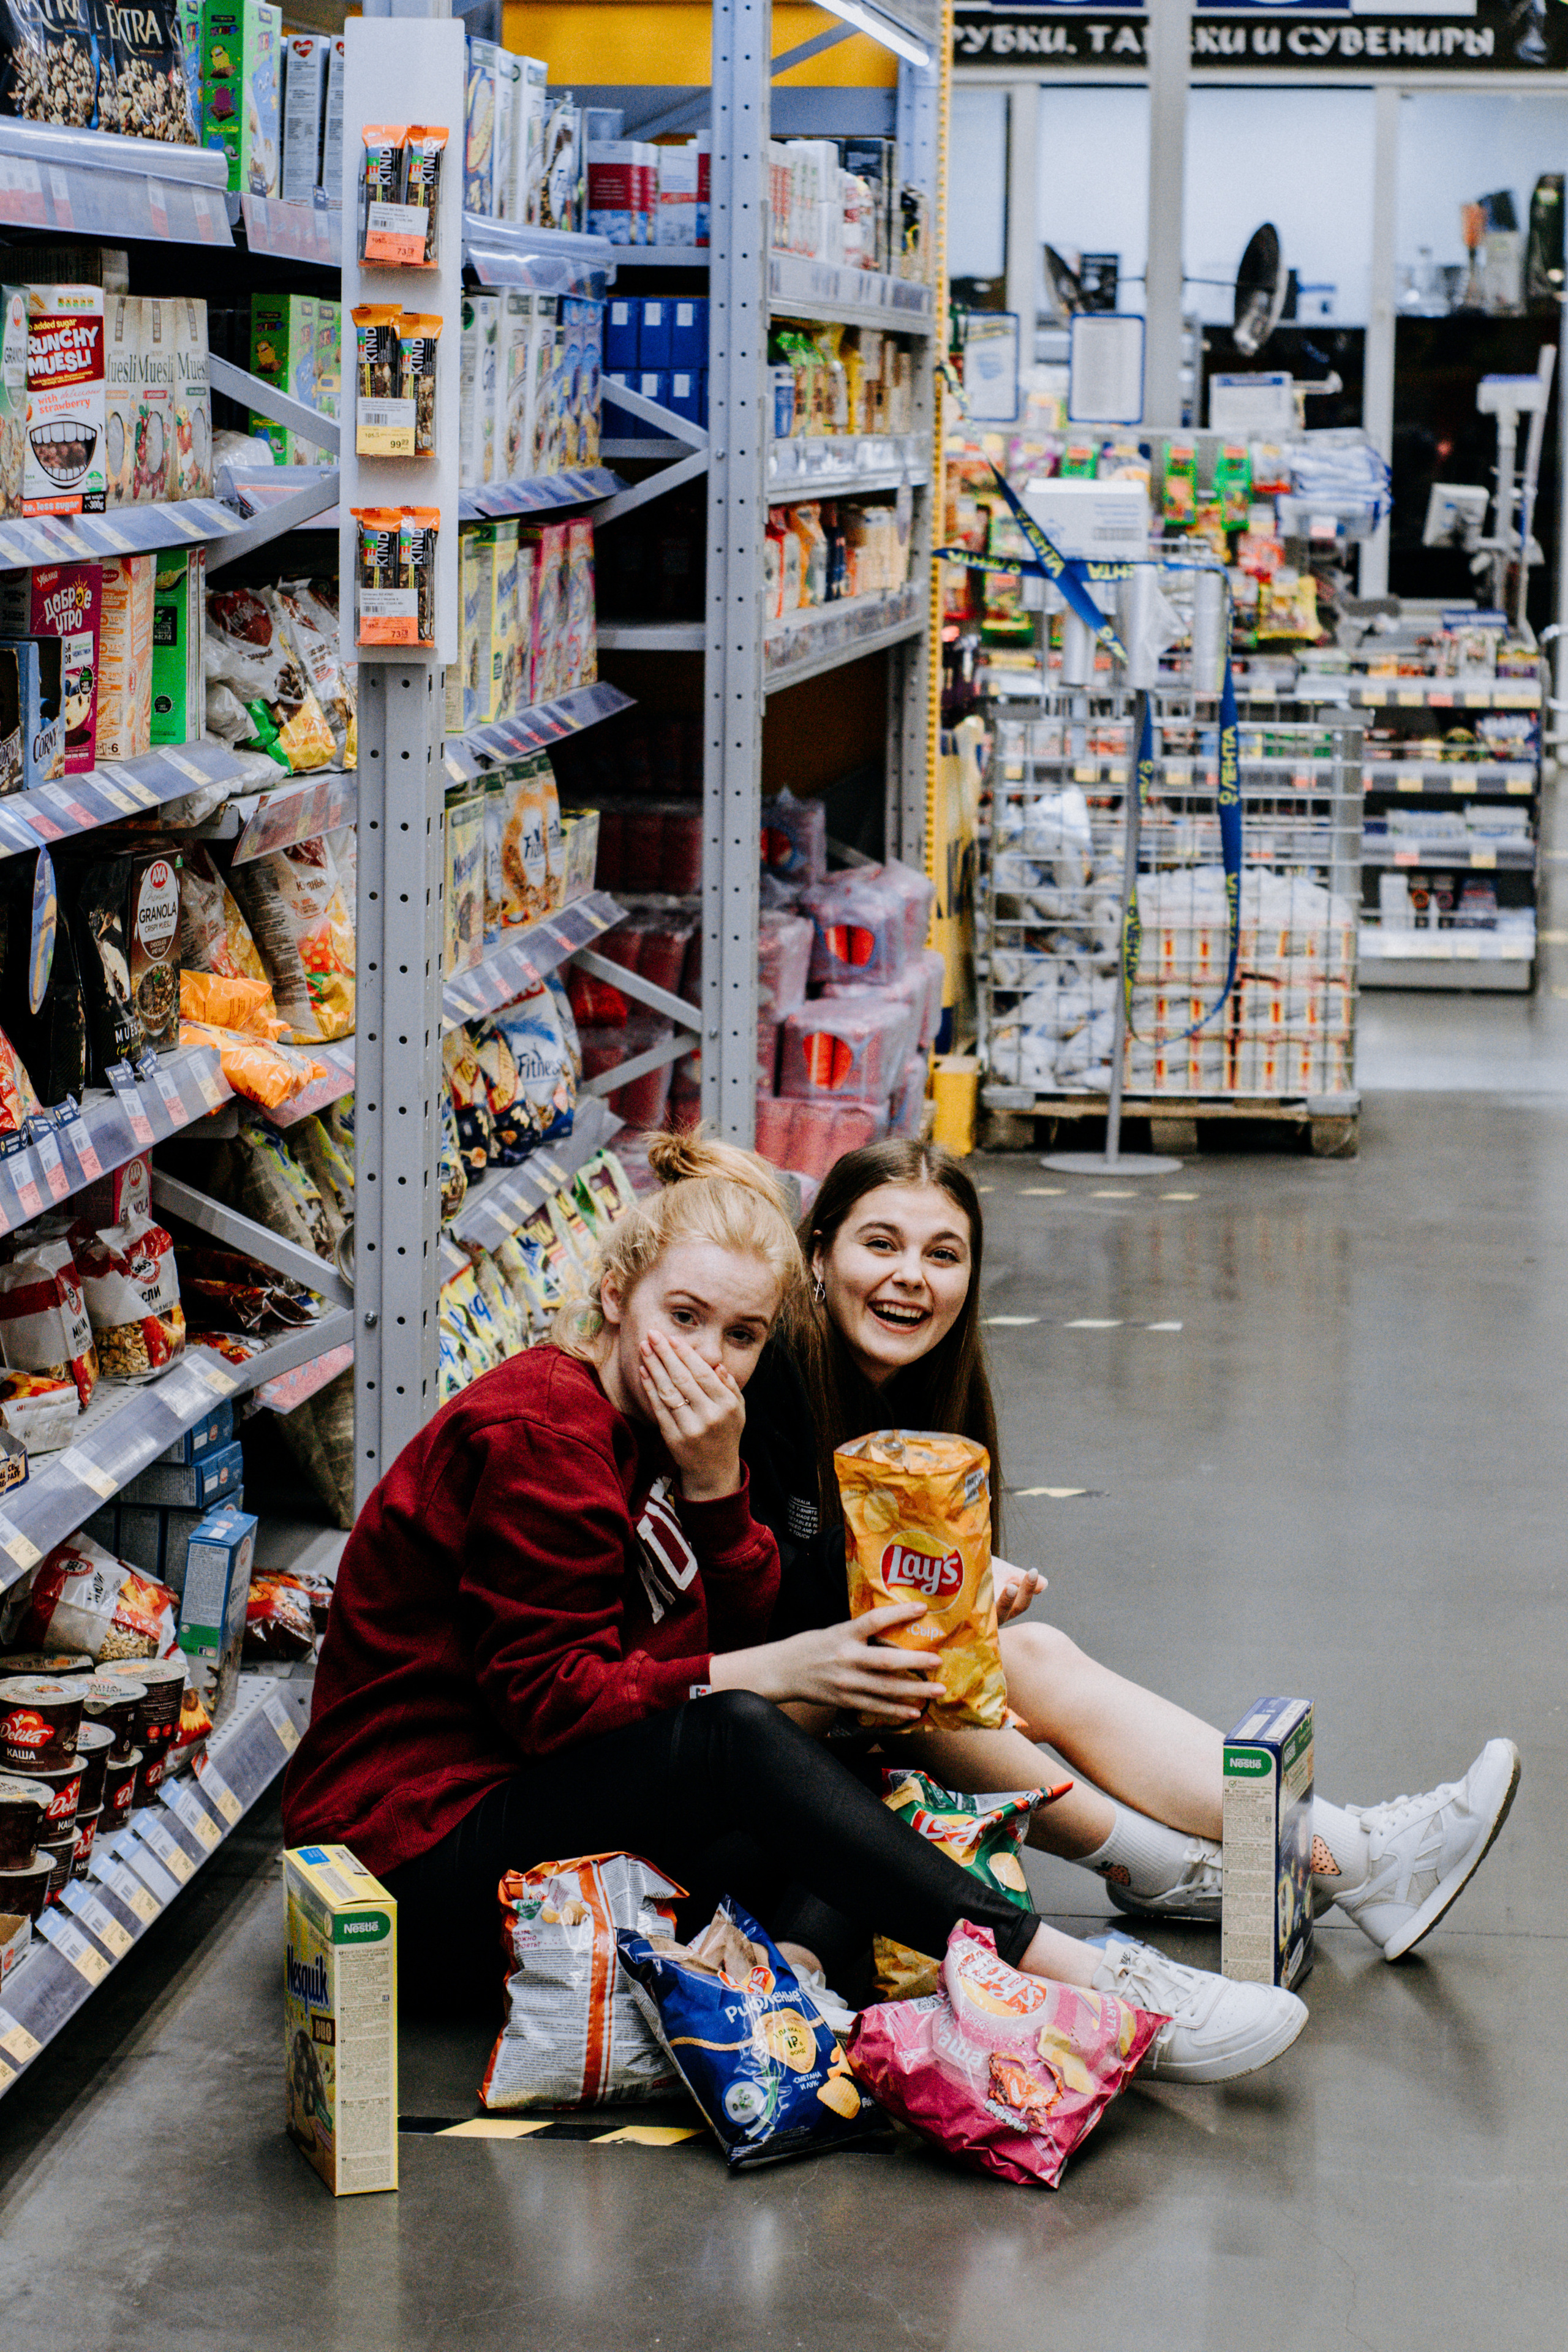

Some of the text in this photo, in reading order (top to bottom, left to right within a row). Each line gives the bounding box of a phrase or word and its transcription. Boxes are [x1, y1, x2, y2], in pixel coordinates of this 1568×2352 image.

[105, 4, 164, 56] EXTRA
[1087, 24, 1246, 55] ТАКИ
[1287, 26, 1495, 57] СУВЕНИРЫ
[380, 149, 392, 185] KIND
[34, 320, 56, 331] added
[56, 318, 77, 330] sugar
[28, 326, 99, 356] RUNCHY
[365, 326, 378, 364] KIND
[28, 349, 92, 377] MUESLI
[138, 354, 174, 383] Muesli
[412, 338, 424, 375] KIND
[38, 394, 58, 404] with
[40, 399, 91, 414] strawberry
[37, 501, 54, 511] less
[55, 500, 79, 512] sugar
[377, 531, 390, 567] KIND
[412, 529, 424, 565] KIND
[56, 609, 83, 635] УТРО
[33, 725, 58, 764] CORNY
[151, 865, 167, 883] AXA
[139, 901, 177, 924] GRANOLA
[115, 1022, 138, 1044] MUES
[132, 1259, 152, 1275] 365
[141, 1285, 161, 1302] СЛИ
[794, 1530, 810, 1539] TOUCH
[888, 1545, 959, 1596] Lay's
[0, 1722, 51, 1745] Delika
[7, 1747, 36, 1760] КАША
[48, 1789, 80, 1816] Deli
[58, 1817, 76, 1831] КАШ
[287, 1944, 329, 2015] Nesquik
[315, 2019, 332, 2043] DUO
